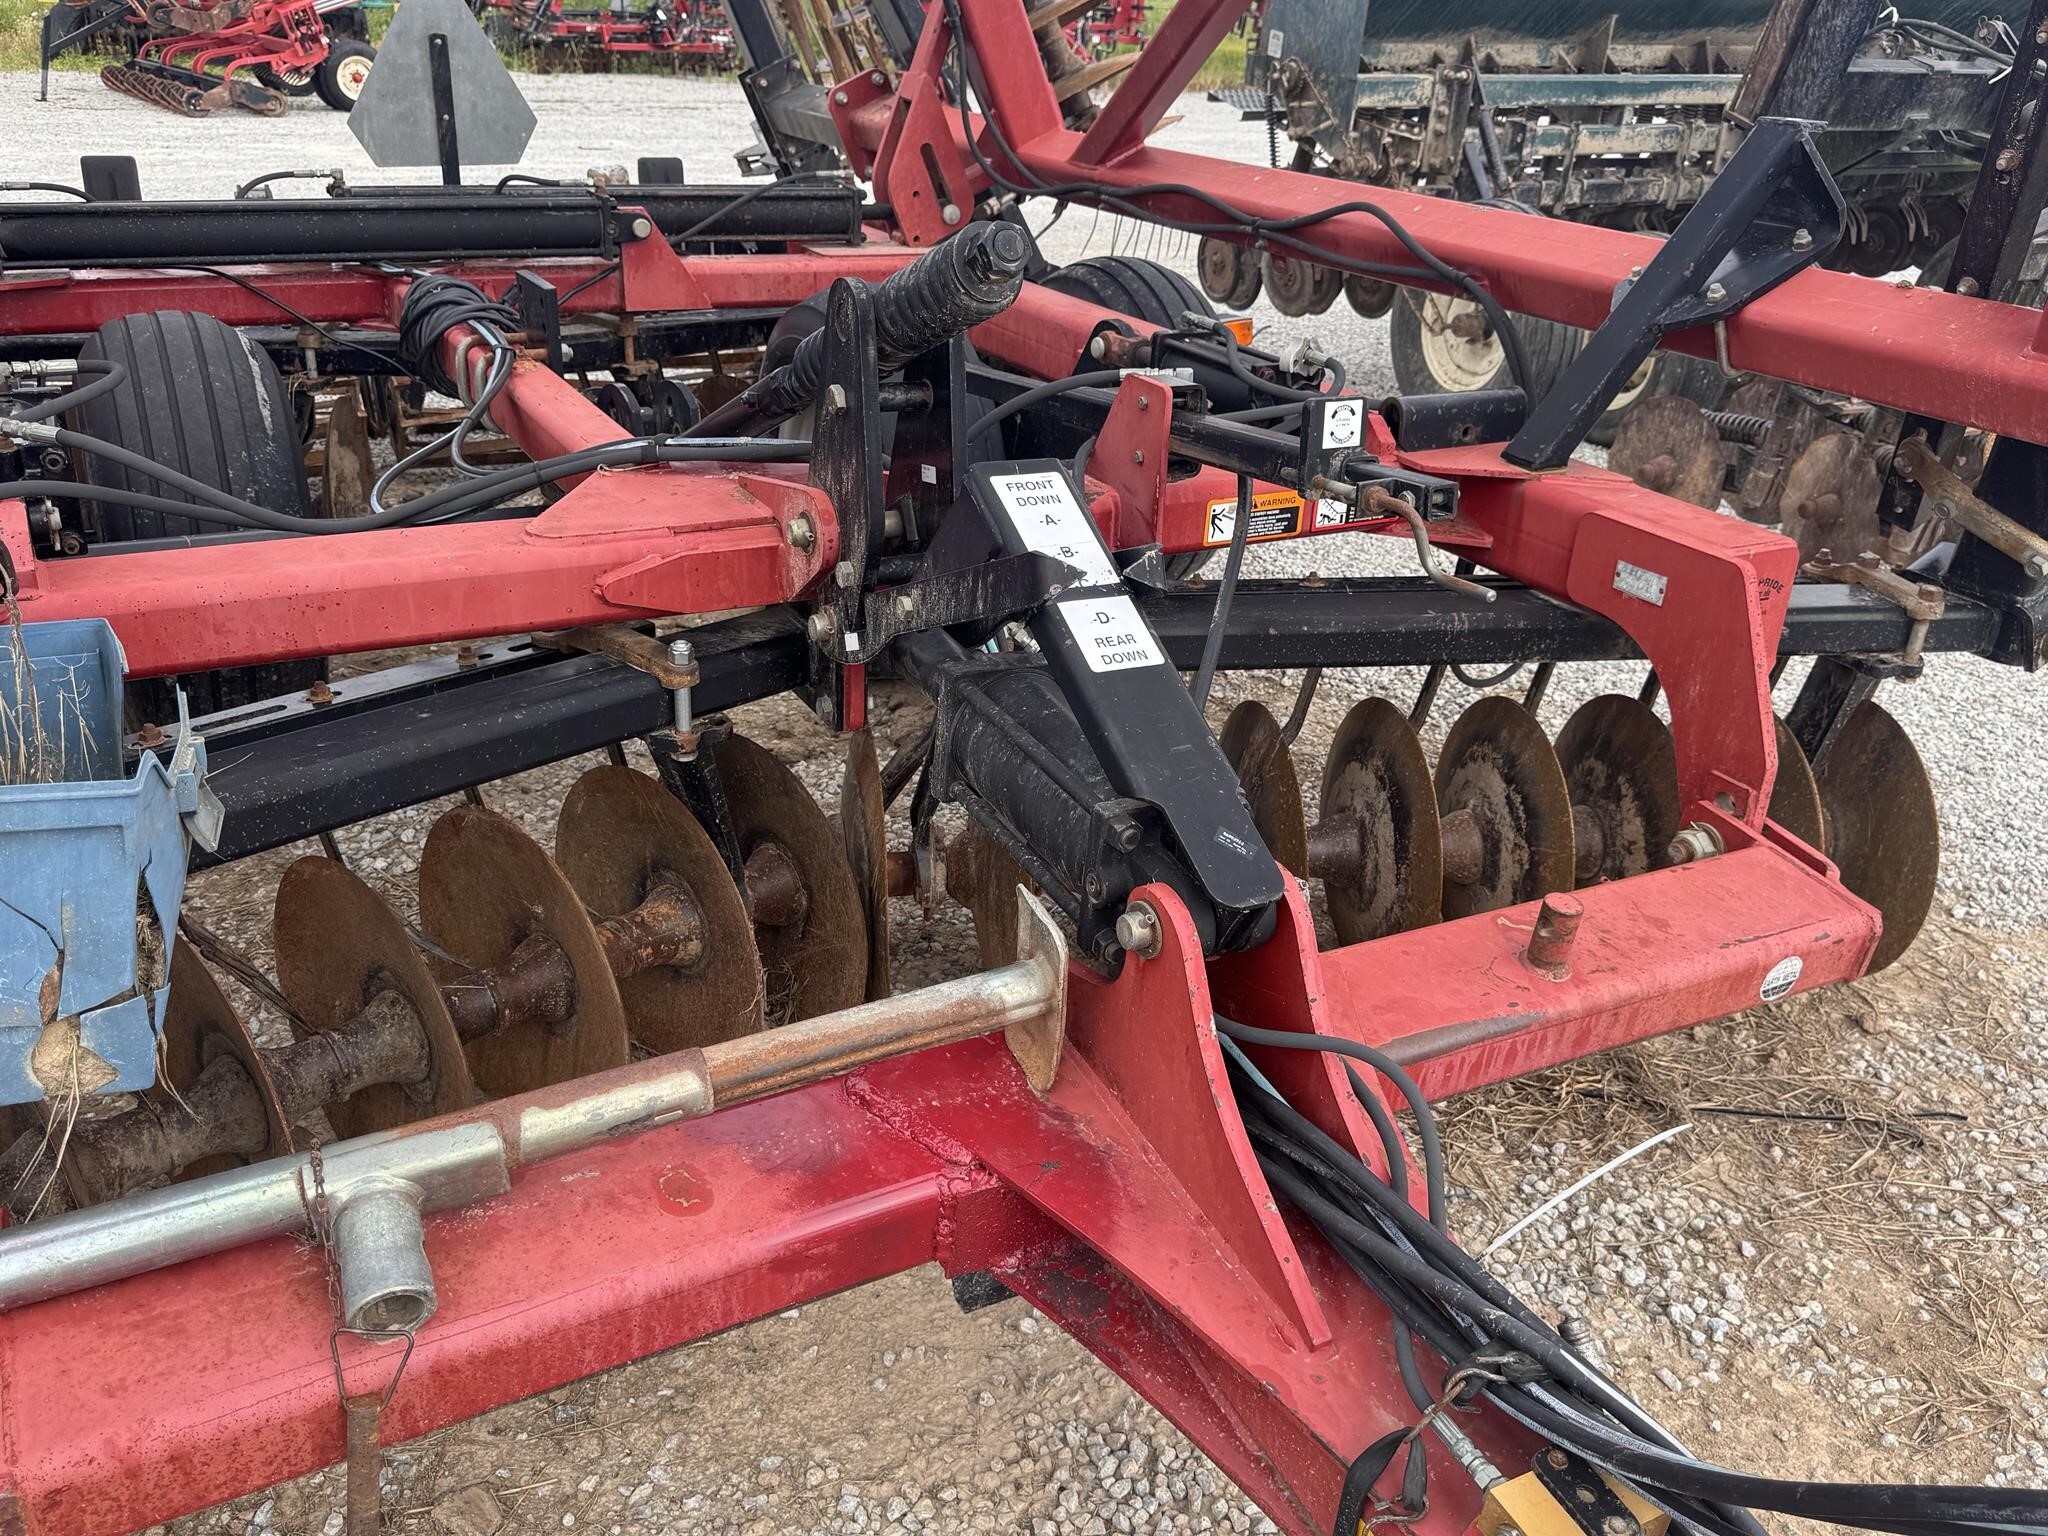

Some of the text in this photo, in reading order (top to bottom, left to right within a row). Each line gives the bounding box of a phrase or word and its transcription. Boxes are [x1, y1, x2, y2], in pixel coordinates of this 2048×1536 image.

[1006, 479, 1054, 492] FRONT
[1016, 494, 1062, 507] DOWN
[1260, 496, 1296, 507] WARNING
[1095, 634, 1137, 648] REAR
[1101, 650, 1149, 665] DOWN
